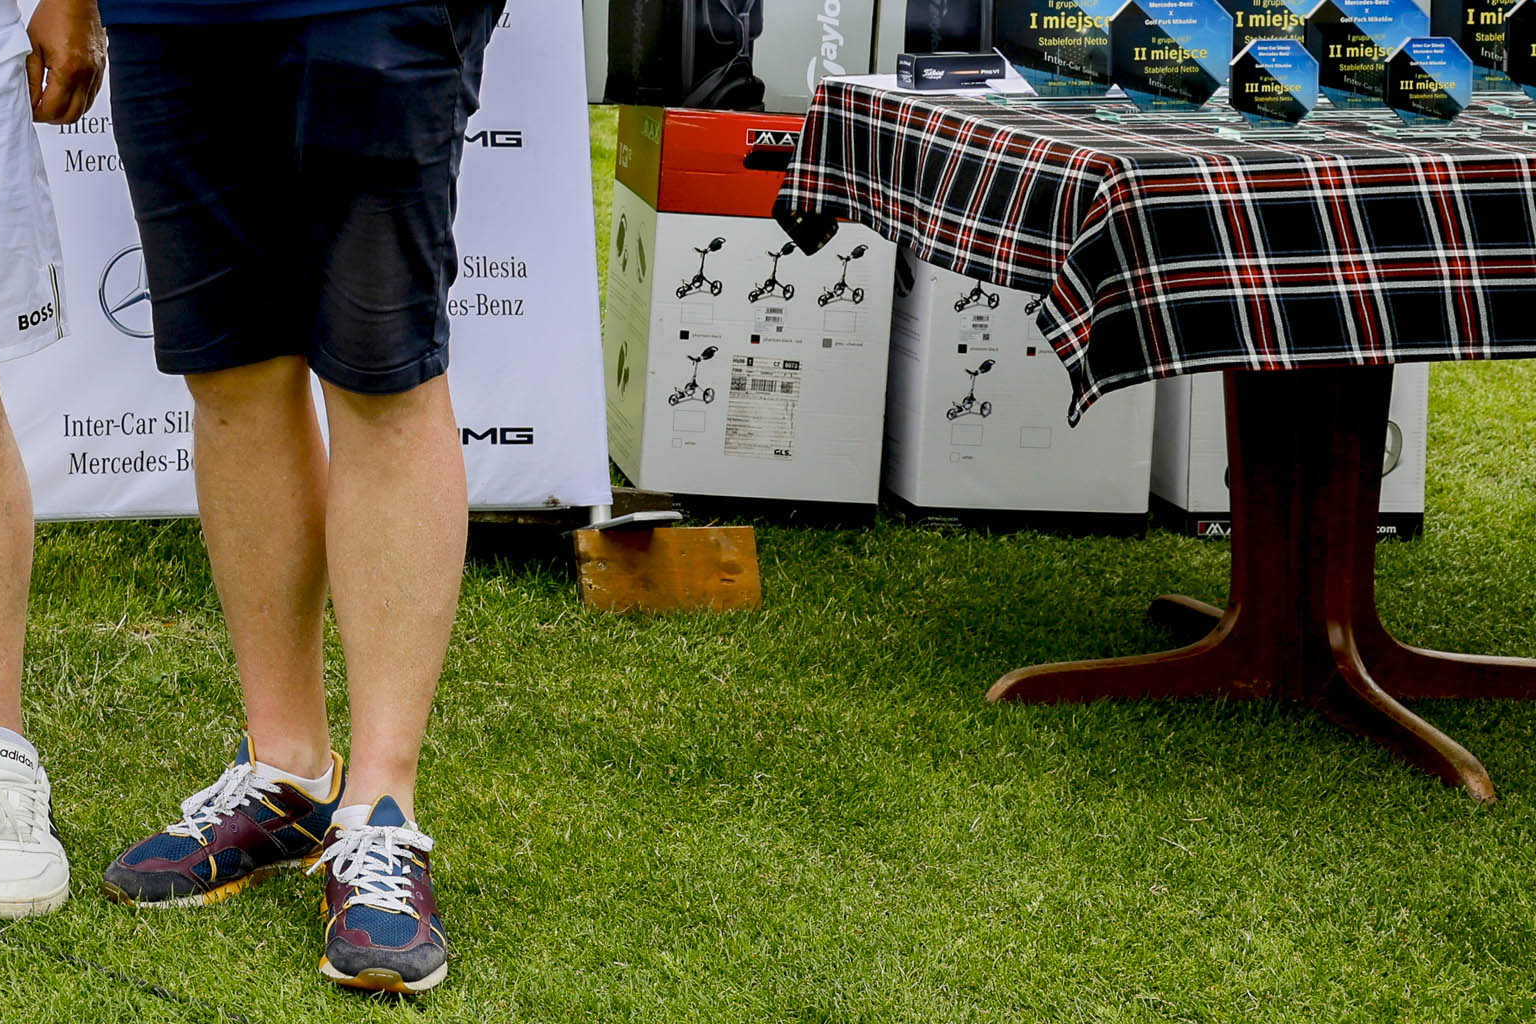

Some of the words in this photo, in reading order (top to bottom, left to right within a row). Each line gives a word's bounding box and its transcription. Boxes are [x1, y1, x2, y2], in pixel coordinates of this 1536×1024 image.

[1056, 1, 1078, 10] grupa
[1038, 36, 1082, 46] Stableford
[1084, 36, 1108, 46] Netto
[1133, 47, 1147, 60] II
[1151, 46, 1208, 63] miejsce
[1329, 45, 1342, 58] II
[1144, 66, 1179, 74] Stableford
[1180, 66, 1199, 74] Netto
[1245, 83, 1259, 93] III
[1261, 82, 1302, 94] miejsce
[1400, 80, 1414, 90] III
[1416, 80, 1456, 92] miejsce
[465, 131, 522, 148] MG
[464, 256, 527, 278] Silesia
[18, 302, 54, 331] BOSS
[64, 412, 157, 437] Inter-Car
[458, 427, 533, 445] MG
